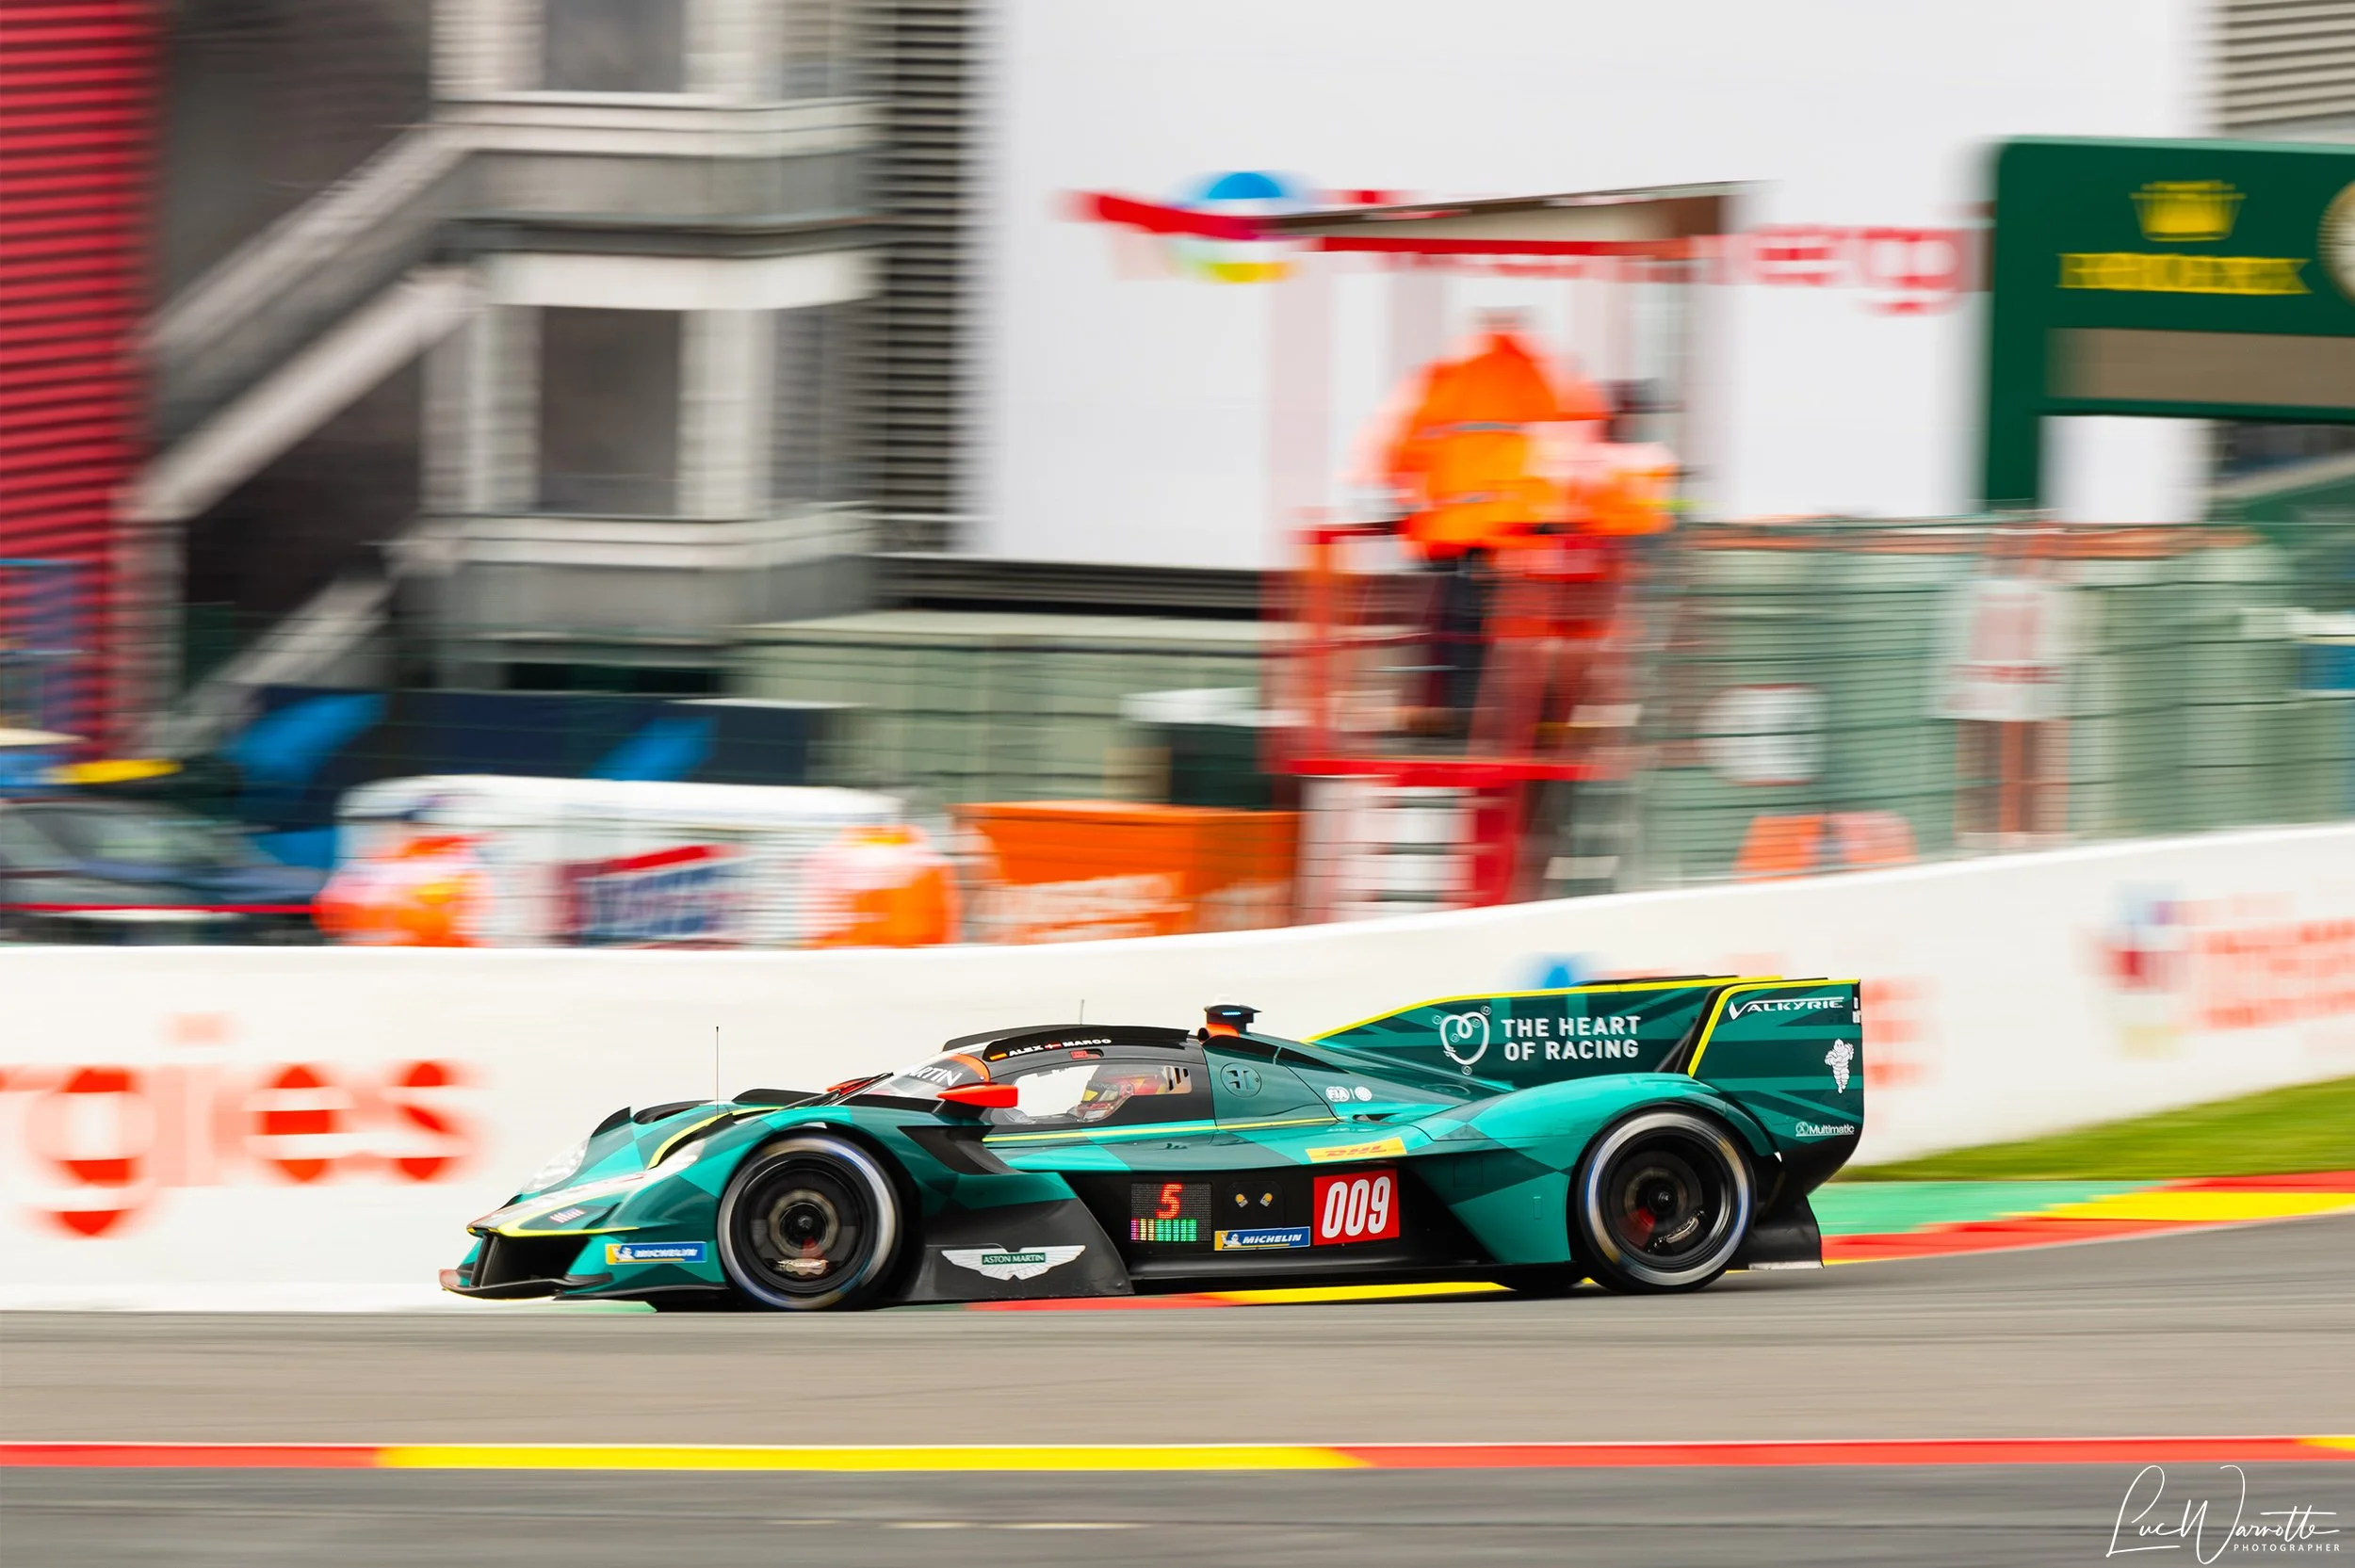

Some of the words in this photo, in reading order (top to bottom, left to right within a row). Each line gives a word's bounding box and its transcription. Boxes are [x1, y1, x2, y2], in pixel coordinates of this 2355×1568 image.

[1728, 996, 1845, 1020] VALKYRIE
[1501, 1018, 1550, 1037] THE
[1558, 1015, 1641, 1036] HEART
[1008, 1044, 1044, 1057] ALEX
[1504, 1042, 1535, 1061] OF
[1545, 1039, 1639, 1060] RACING
[1809, 1123, 1855, 1135] Multimatic
[1156, 1182, 1183, 1220] 5
[1321, 1176, 1391, 1239] 009
[983, 1254, 1011, 1264] ASTON
[1013, 1253, 1045, 1263] MARTIN
